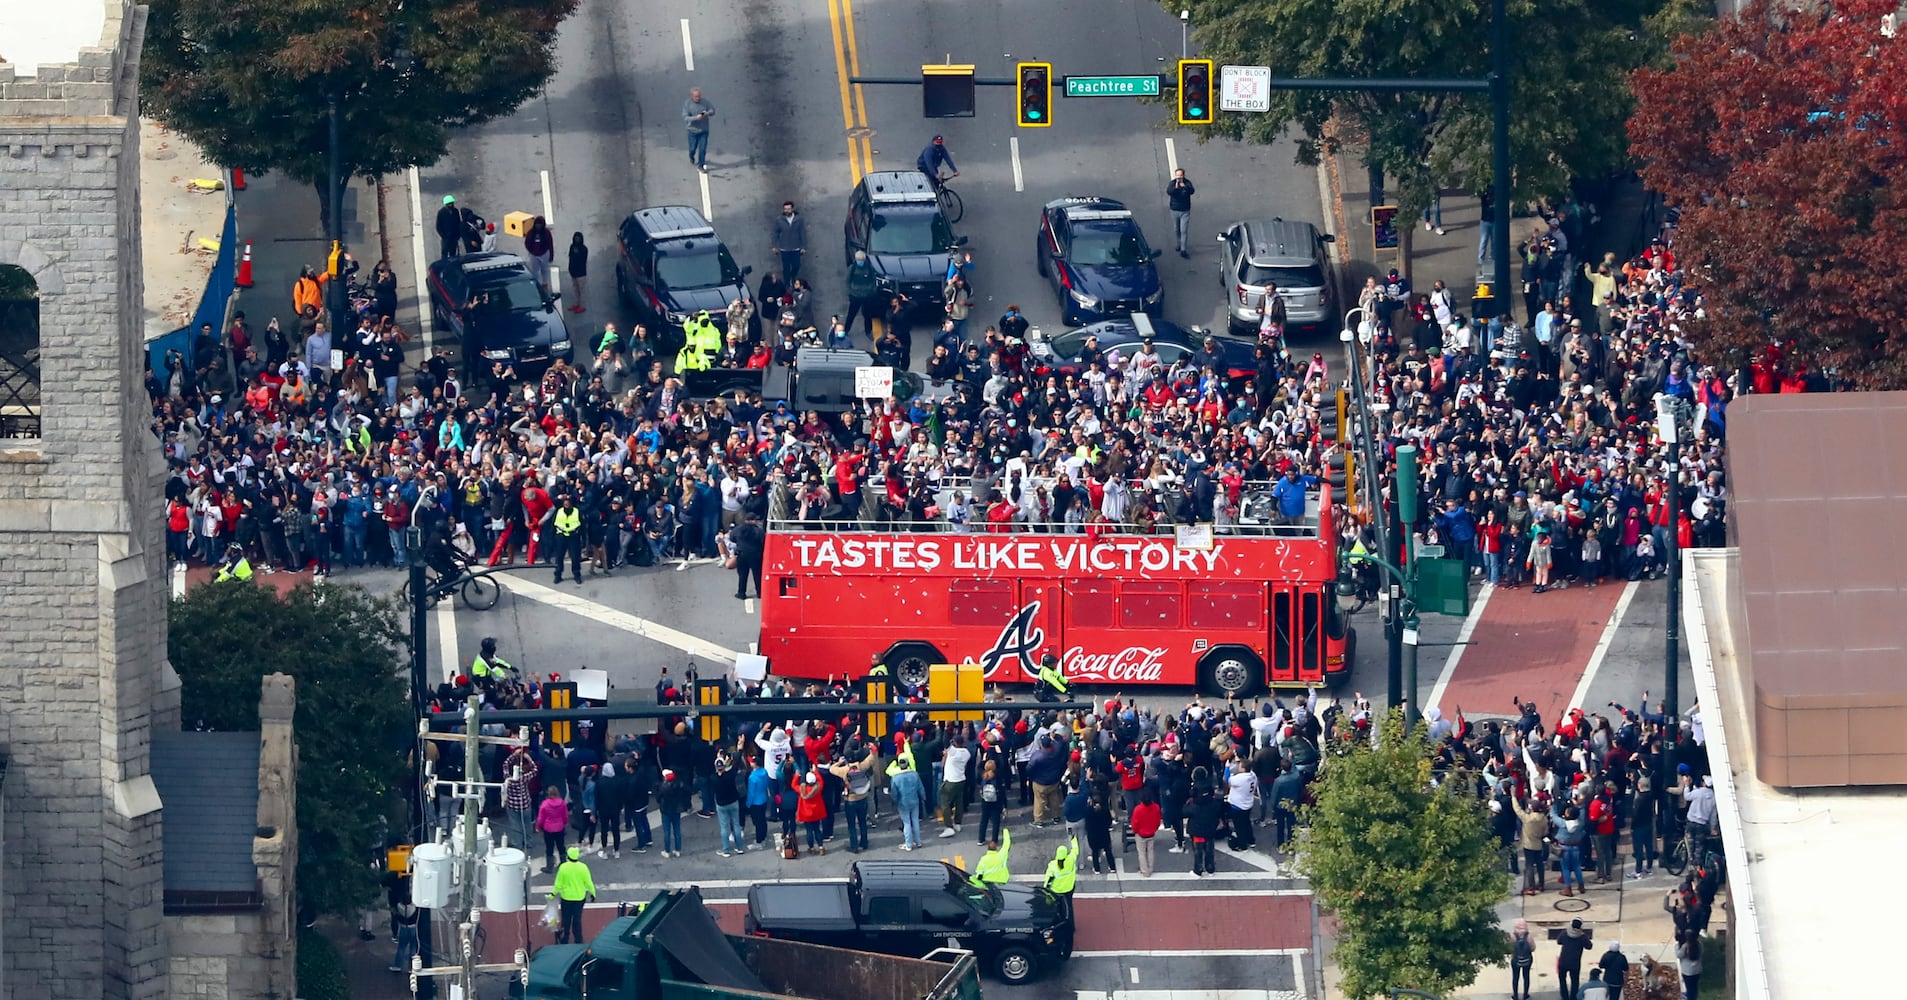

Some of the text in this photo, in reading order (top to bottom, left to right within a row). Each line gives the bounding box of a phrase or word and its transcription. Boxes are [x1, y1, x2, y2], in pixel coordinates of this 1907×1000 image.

[1070, 80, 1156, 92] Peachtree St
[1226, 99, 1264, 108] THE BOX
[792, 541, 1224, 571] TASTES LIKE VICTORY
[972, 600, 1044, 678] A
[1061, 646, 1168, 681] Coca-Cola
[775, 754, 782, 764] 5
